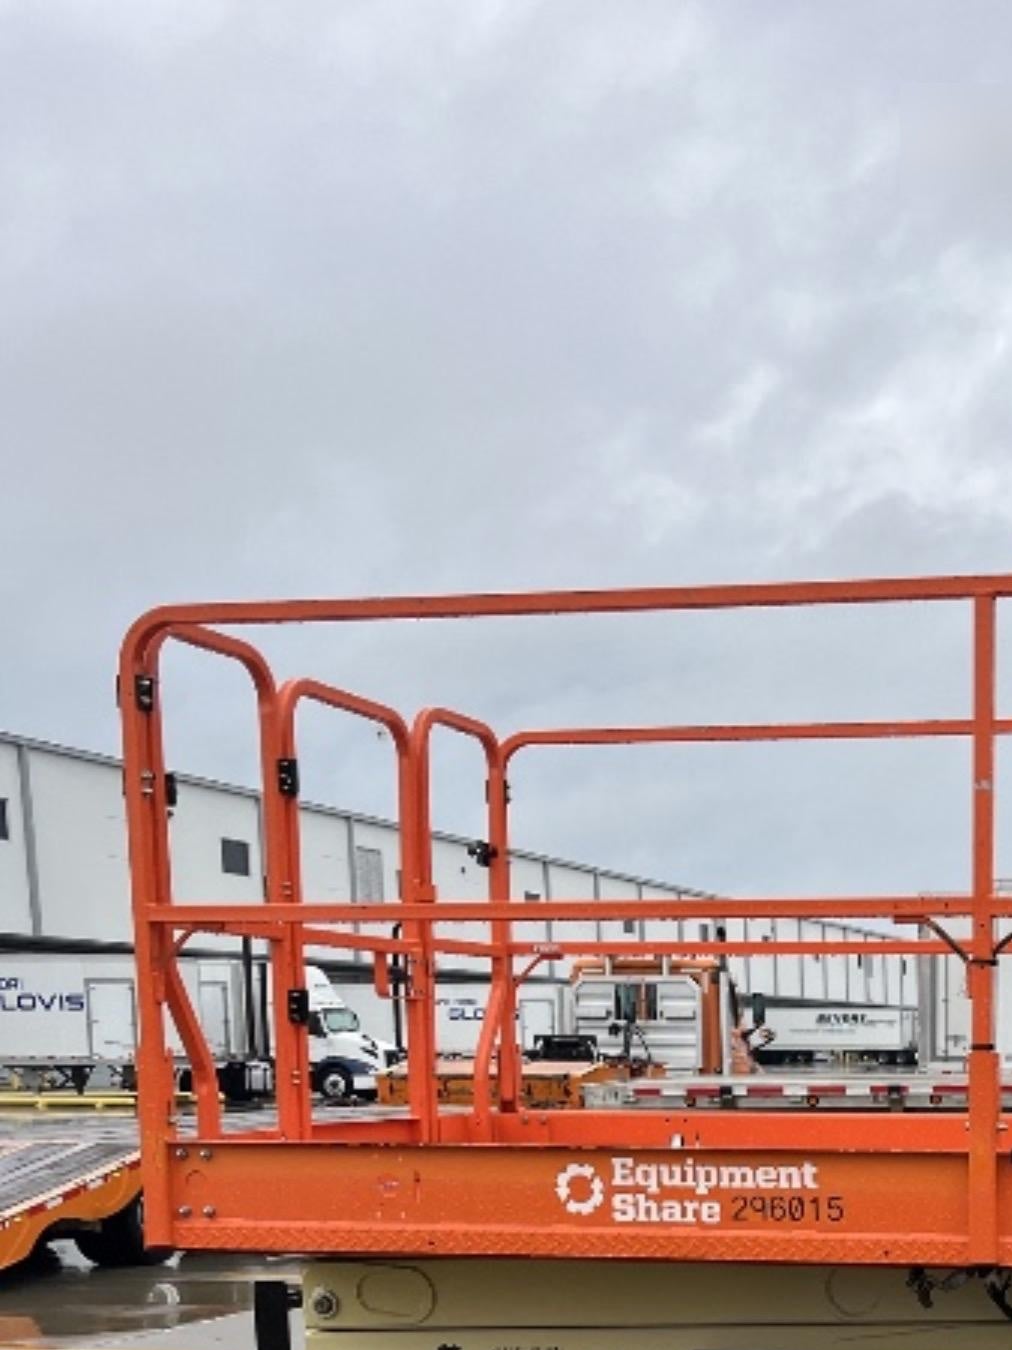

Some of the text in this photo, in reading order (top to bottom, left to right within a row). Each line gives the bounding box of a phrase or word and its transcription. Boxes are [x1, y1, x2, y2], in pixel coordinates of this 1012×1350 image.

[0, 993, 84, 1011] LOVIS
[611, 1157, 818, 1194] Equipment
[612, 1193, 721, 1223] Share
[731, 1195, 844, 1222] 296015
